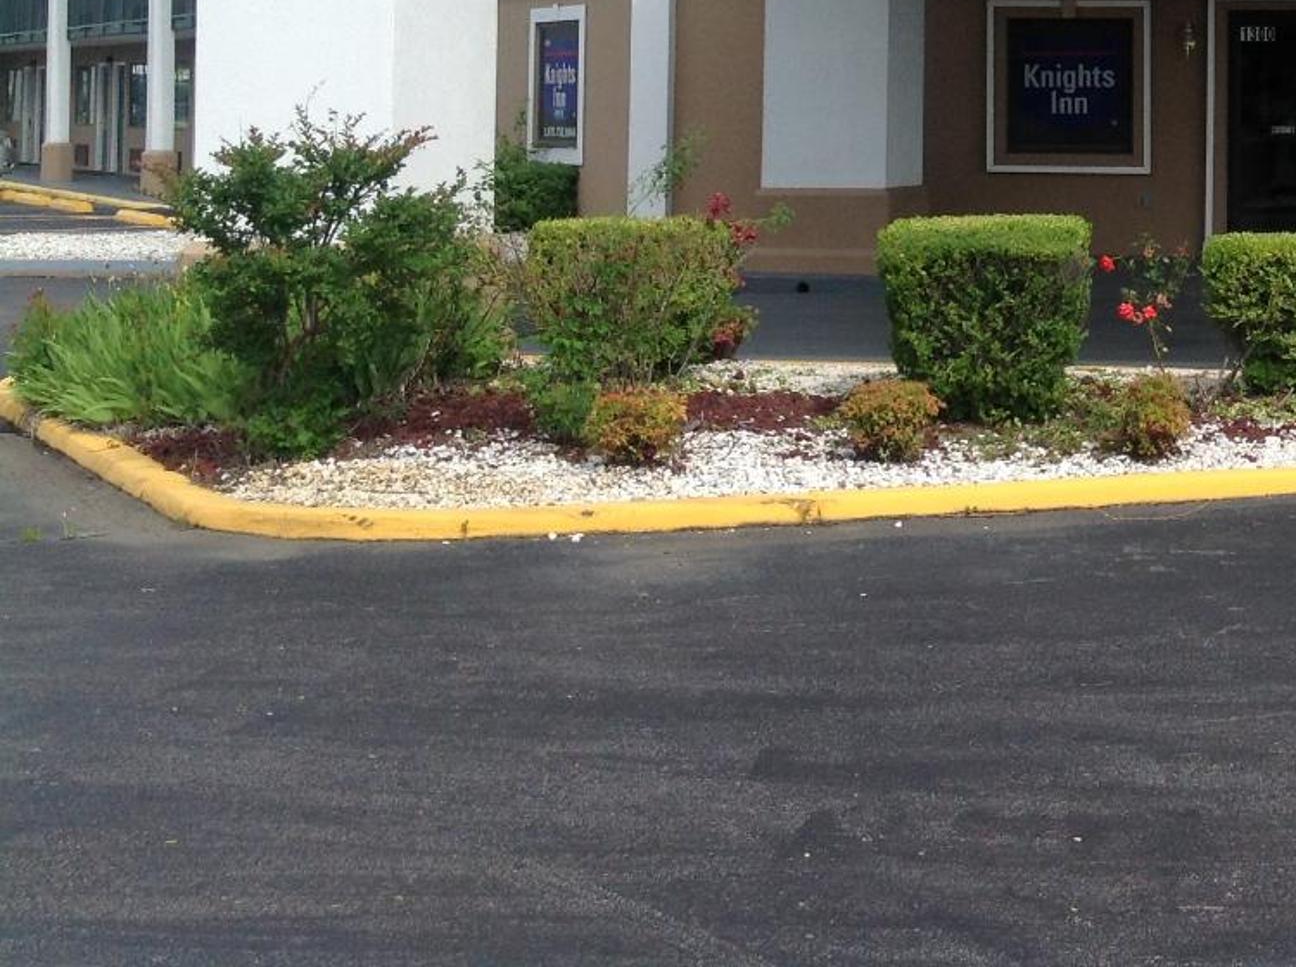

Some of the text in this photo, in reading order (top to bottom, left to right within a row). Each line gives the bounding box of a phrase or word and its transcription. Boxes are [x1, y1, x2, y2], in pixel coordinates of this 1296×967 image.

[544, 62, 577, 89] Knights
[1024, 63, 1116, 93] Knights
[552, 85, 567, 108] Inn
[1050, 90, 1089, 115] Inn
